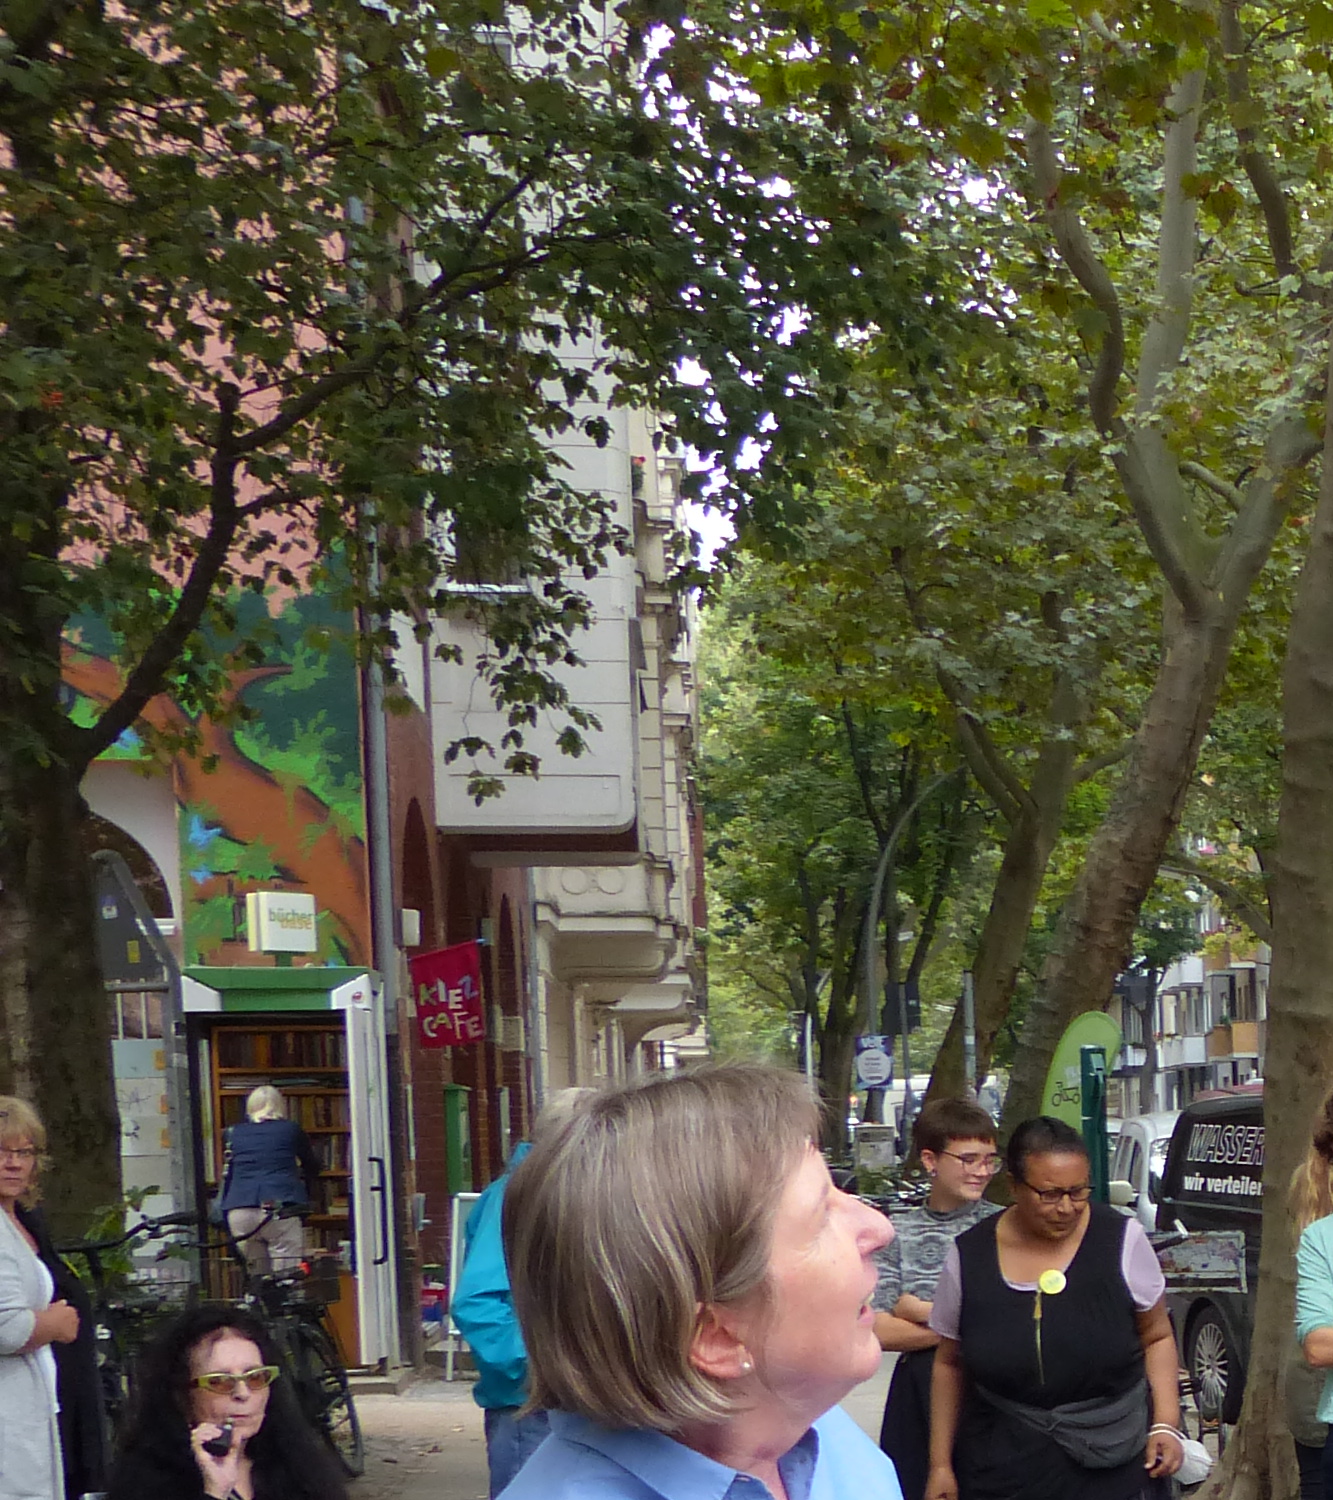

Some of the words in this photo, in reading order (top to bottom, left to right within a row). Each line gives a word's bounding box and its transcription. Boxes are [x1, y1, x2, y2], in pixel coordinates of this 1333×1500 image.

[419, 975, 479, 1009] KIEZ
[423, 1012, 483, 1039] CAFE
[1187, 1124, 1265, 1165] WASSER
[1184, 1172, 1205, 1191] wir
